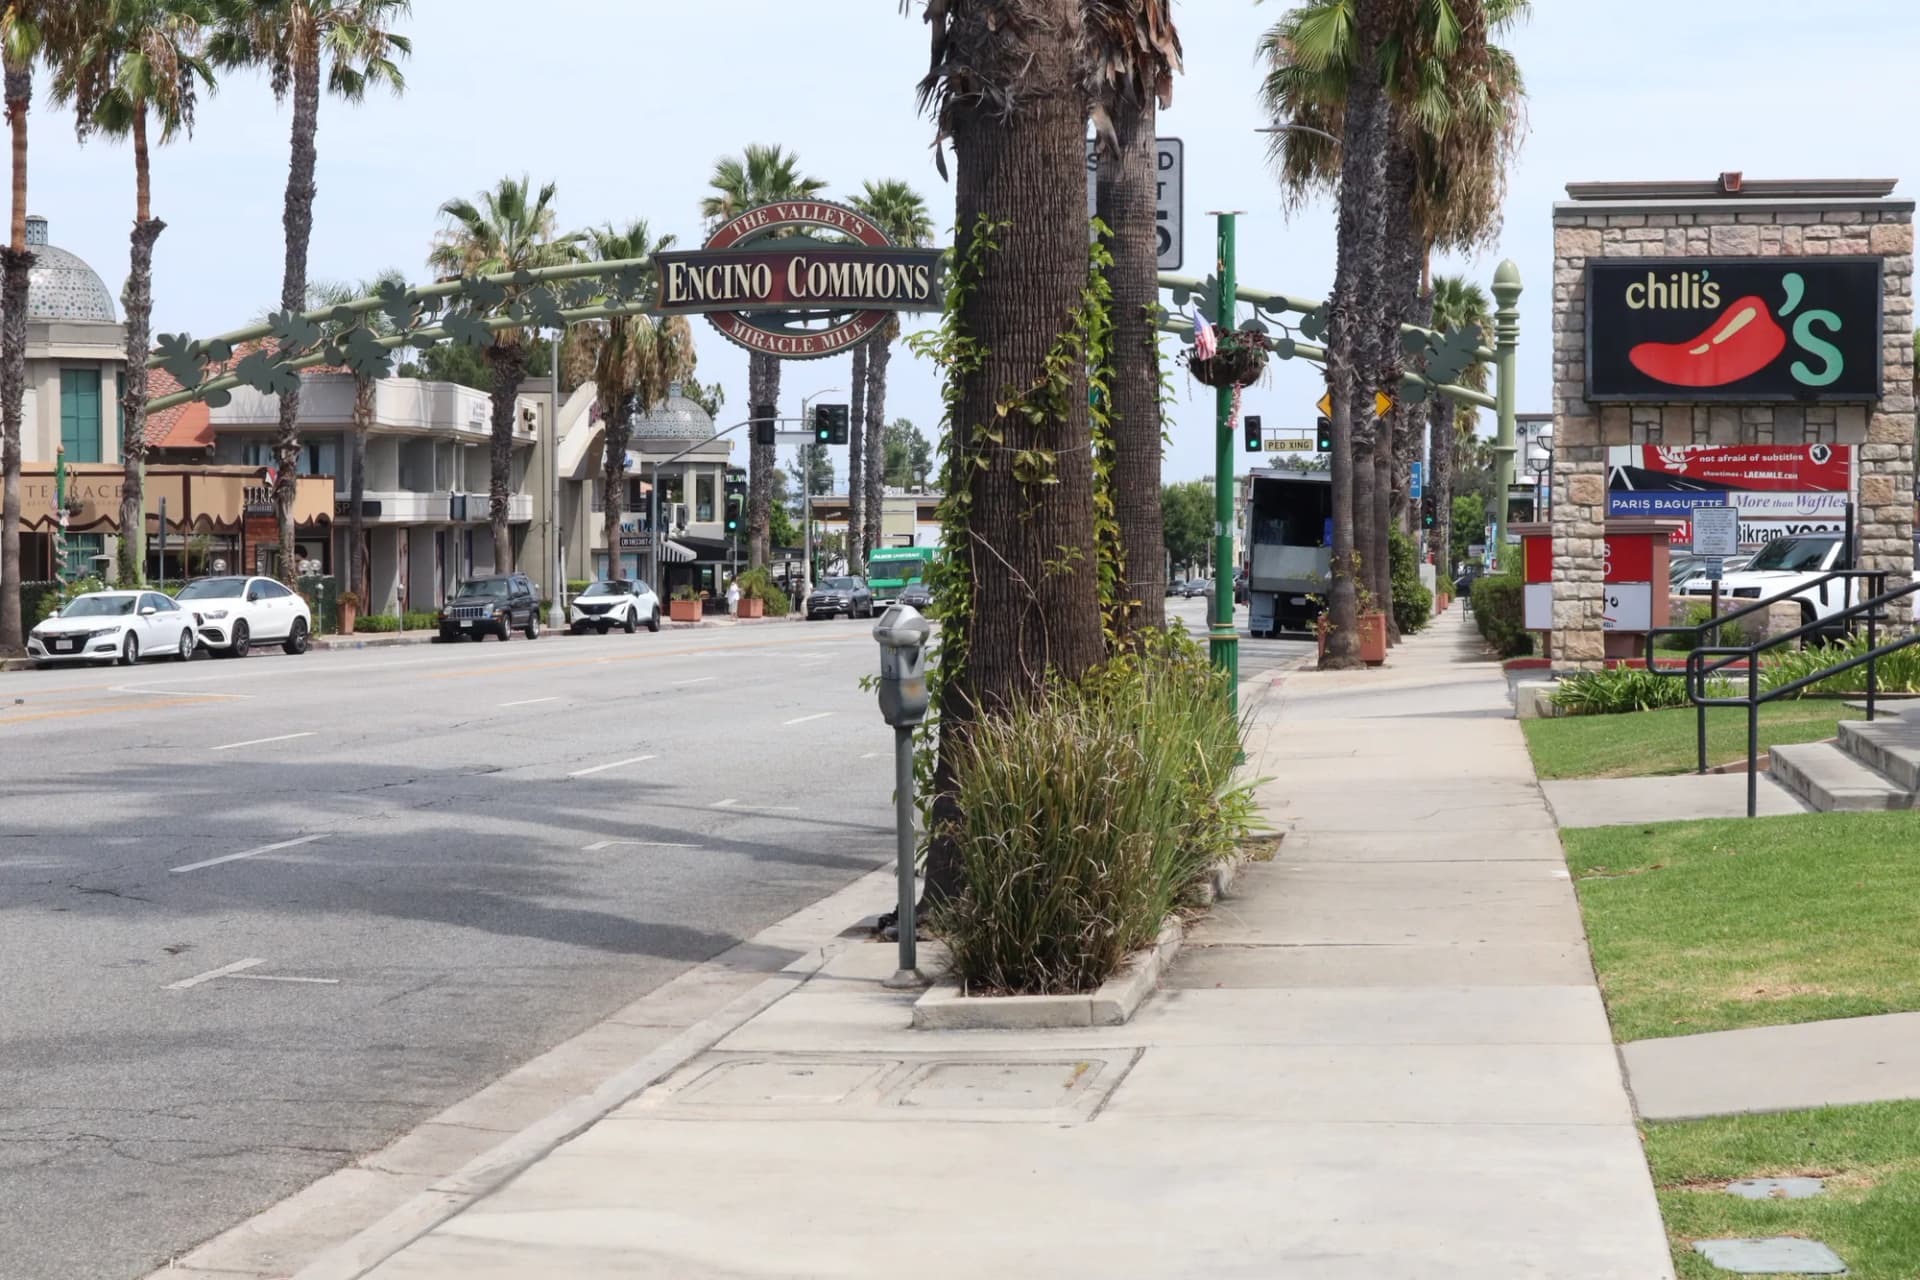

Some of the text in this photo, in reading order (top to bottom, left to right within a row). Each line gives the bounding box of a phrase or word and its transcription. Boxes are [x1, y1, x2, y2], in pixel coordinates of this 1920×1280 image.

[729, 205, 865, 236] THE VALLEY'S
[667, 256, 930, 302] ENCINO COMMONS
[1625, 269, 1721, 310] chili's
[729, 319, 867, 353] MIRACLE MILE
[1268, 440, 1310, 450] PED XING
[1699, 452, 1804, 463] not afraid of subtitles
[24, 484, 122, 499] TERACE
[1612, 499, 1723, 509] PARIS BAGUETTE
[1736, 494, 1847, 515] More than Waffles
